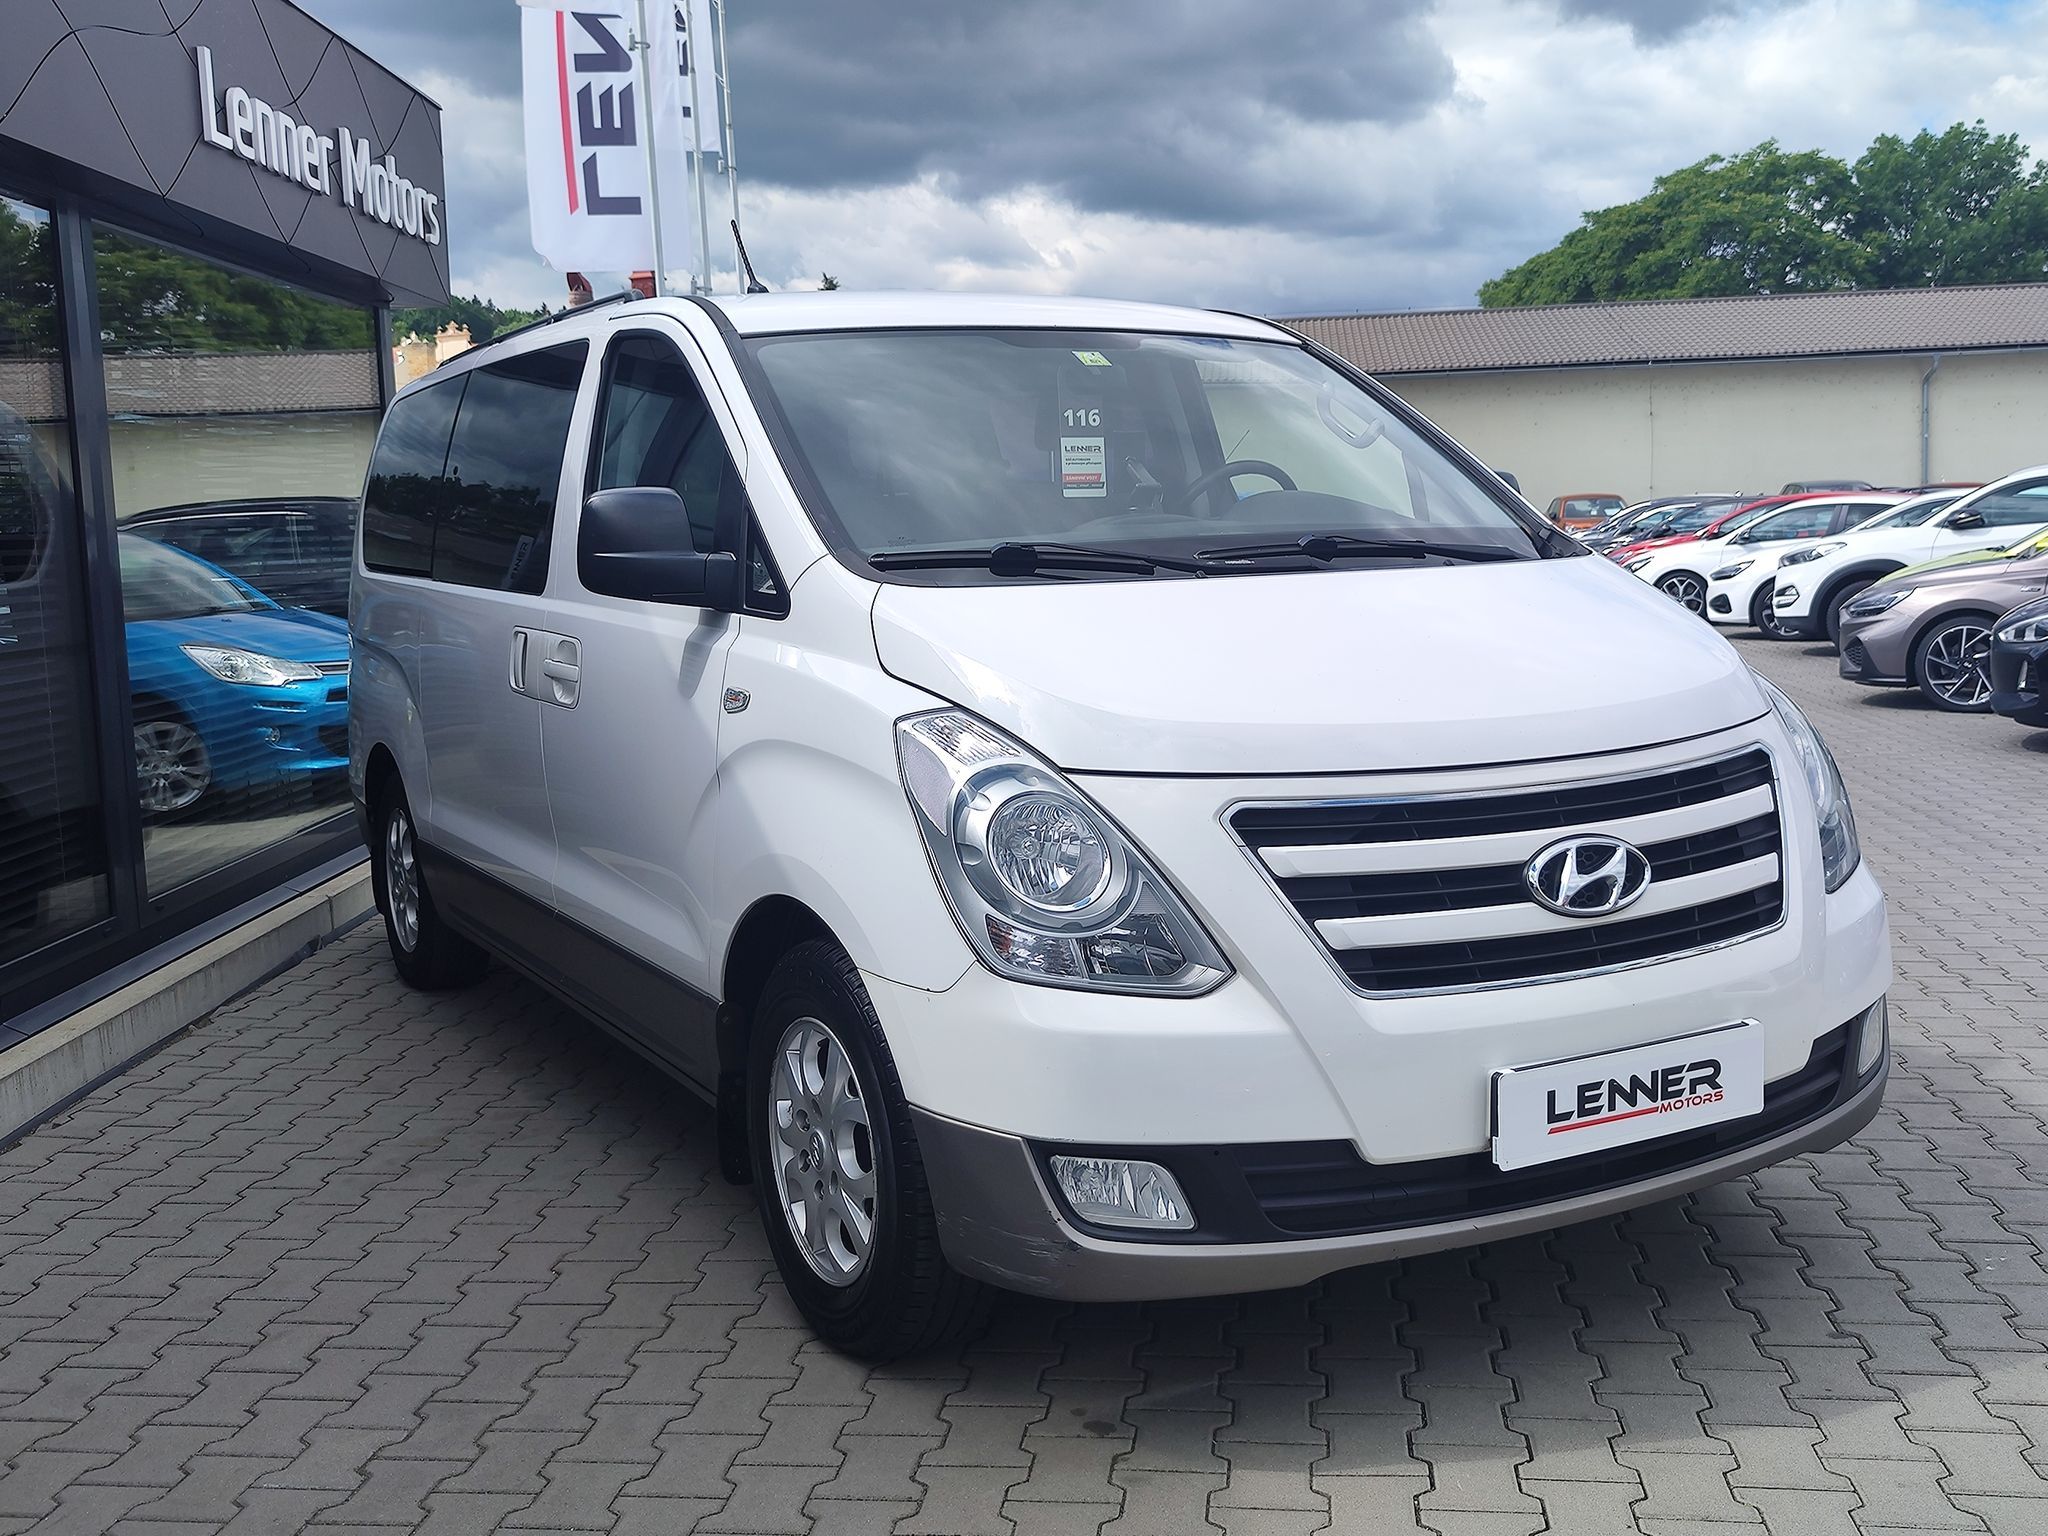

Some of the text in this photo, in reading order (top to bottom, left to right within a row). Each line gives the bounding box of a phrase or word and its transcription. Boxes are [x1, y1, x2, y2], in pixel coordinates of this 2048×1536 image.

[196, 46, 440, 246] Lenner Motors
[1063, 409, 1101, 427] 116
[1064, 445, 1102, 453] LENNER
[1547, 1058, 1724, 1125] LENNER
[1659, 1089, 1724, 1114] MOTORS
